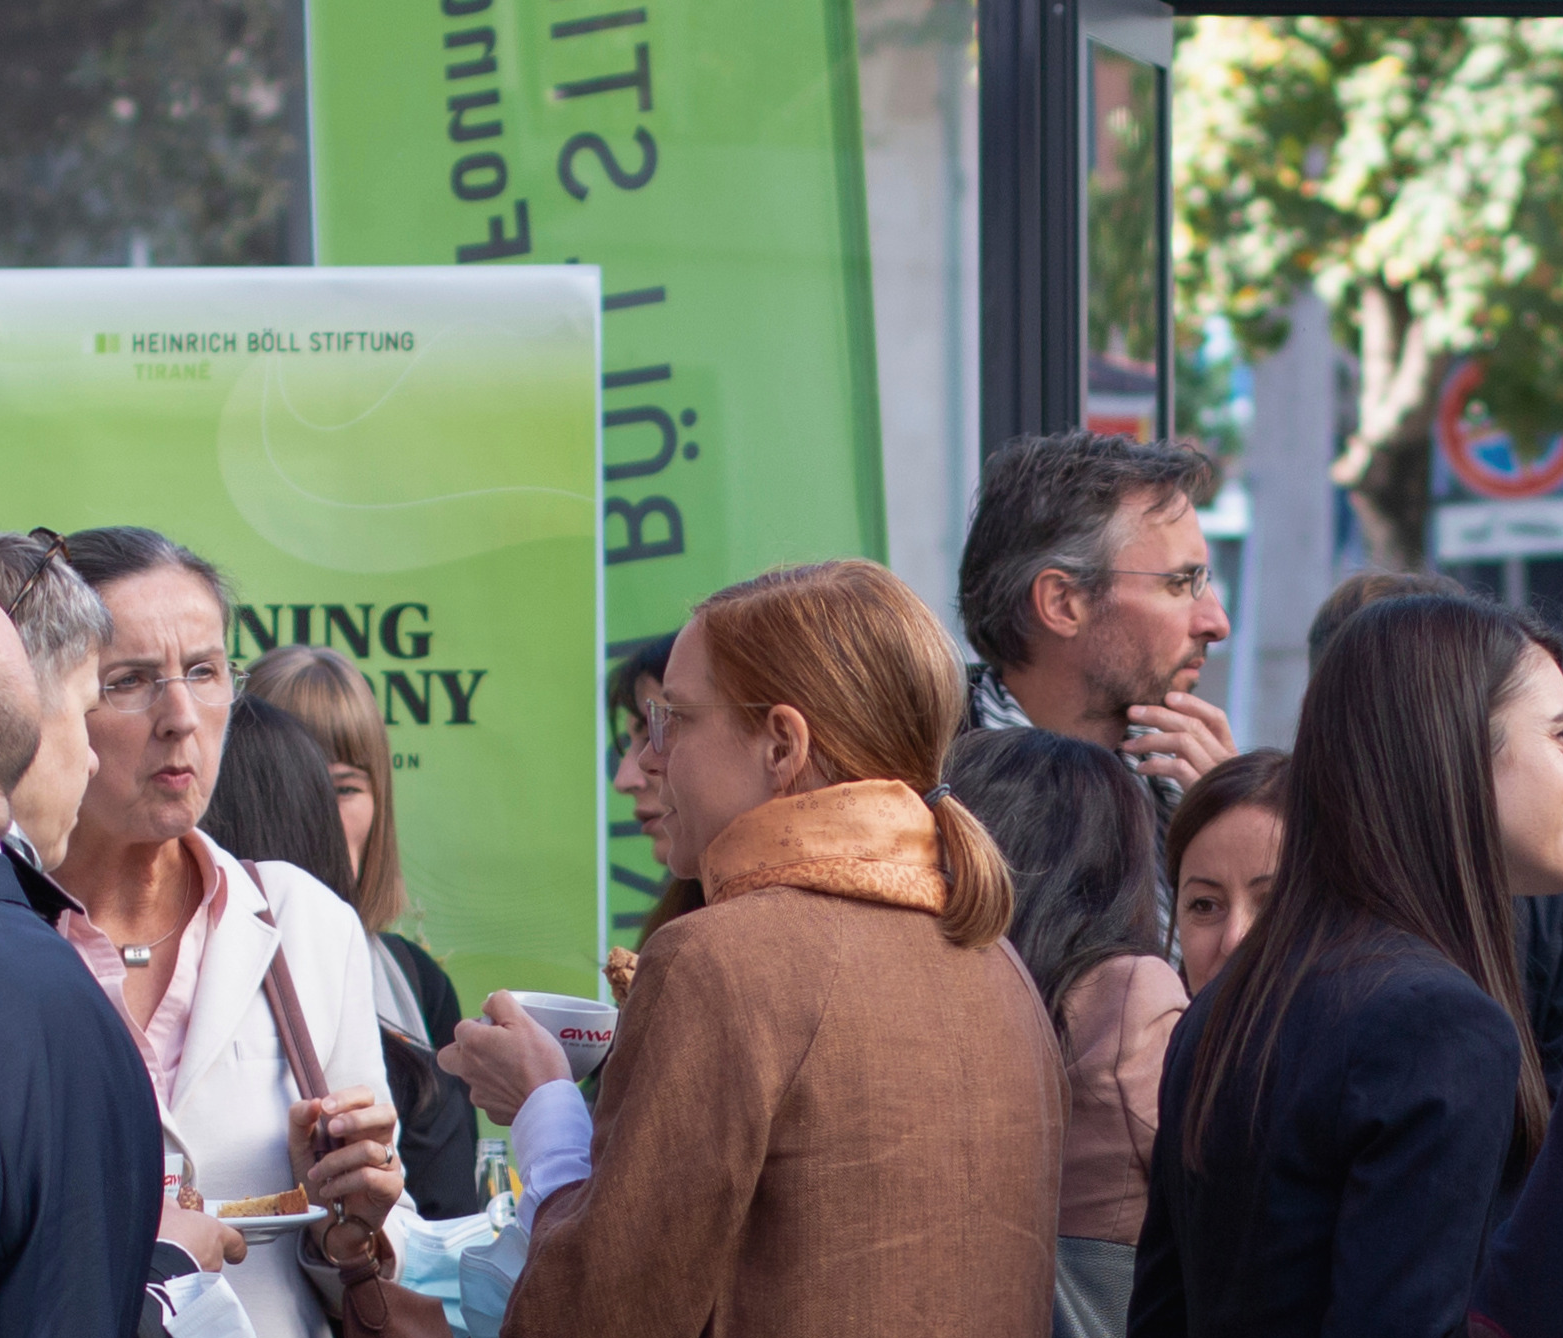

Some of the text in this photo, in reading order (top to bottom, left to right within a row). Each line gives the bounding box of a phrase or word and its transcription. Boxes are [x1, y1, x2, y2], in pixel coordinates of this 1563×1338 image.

[131, 327, 415, 354] HEINRICH BÖLL STIFTUNG
